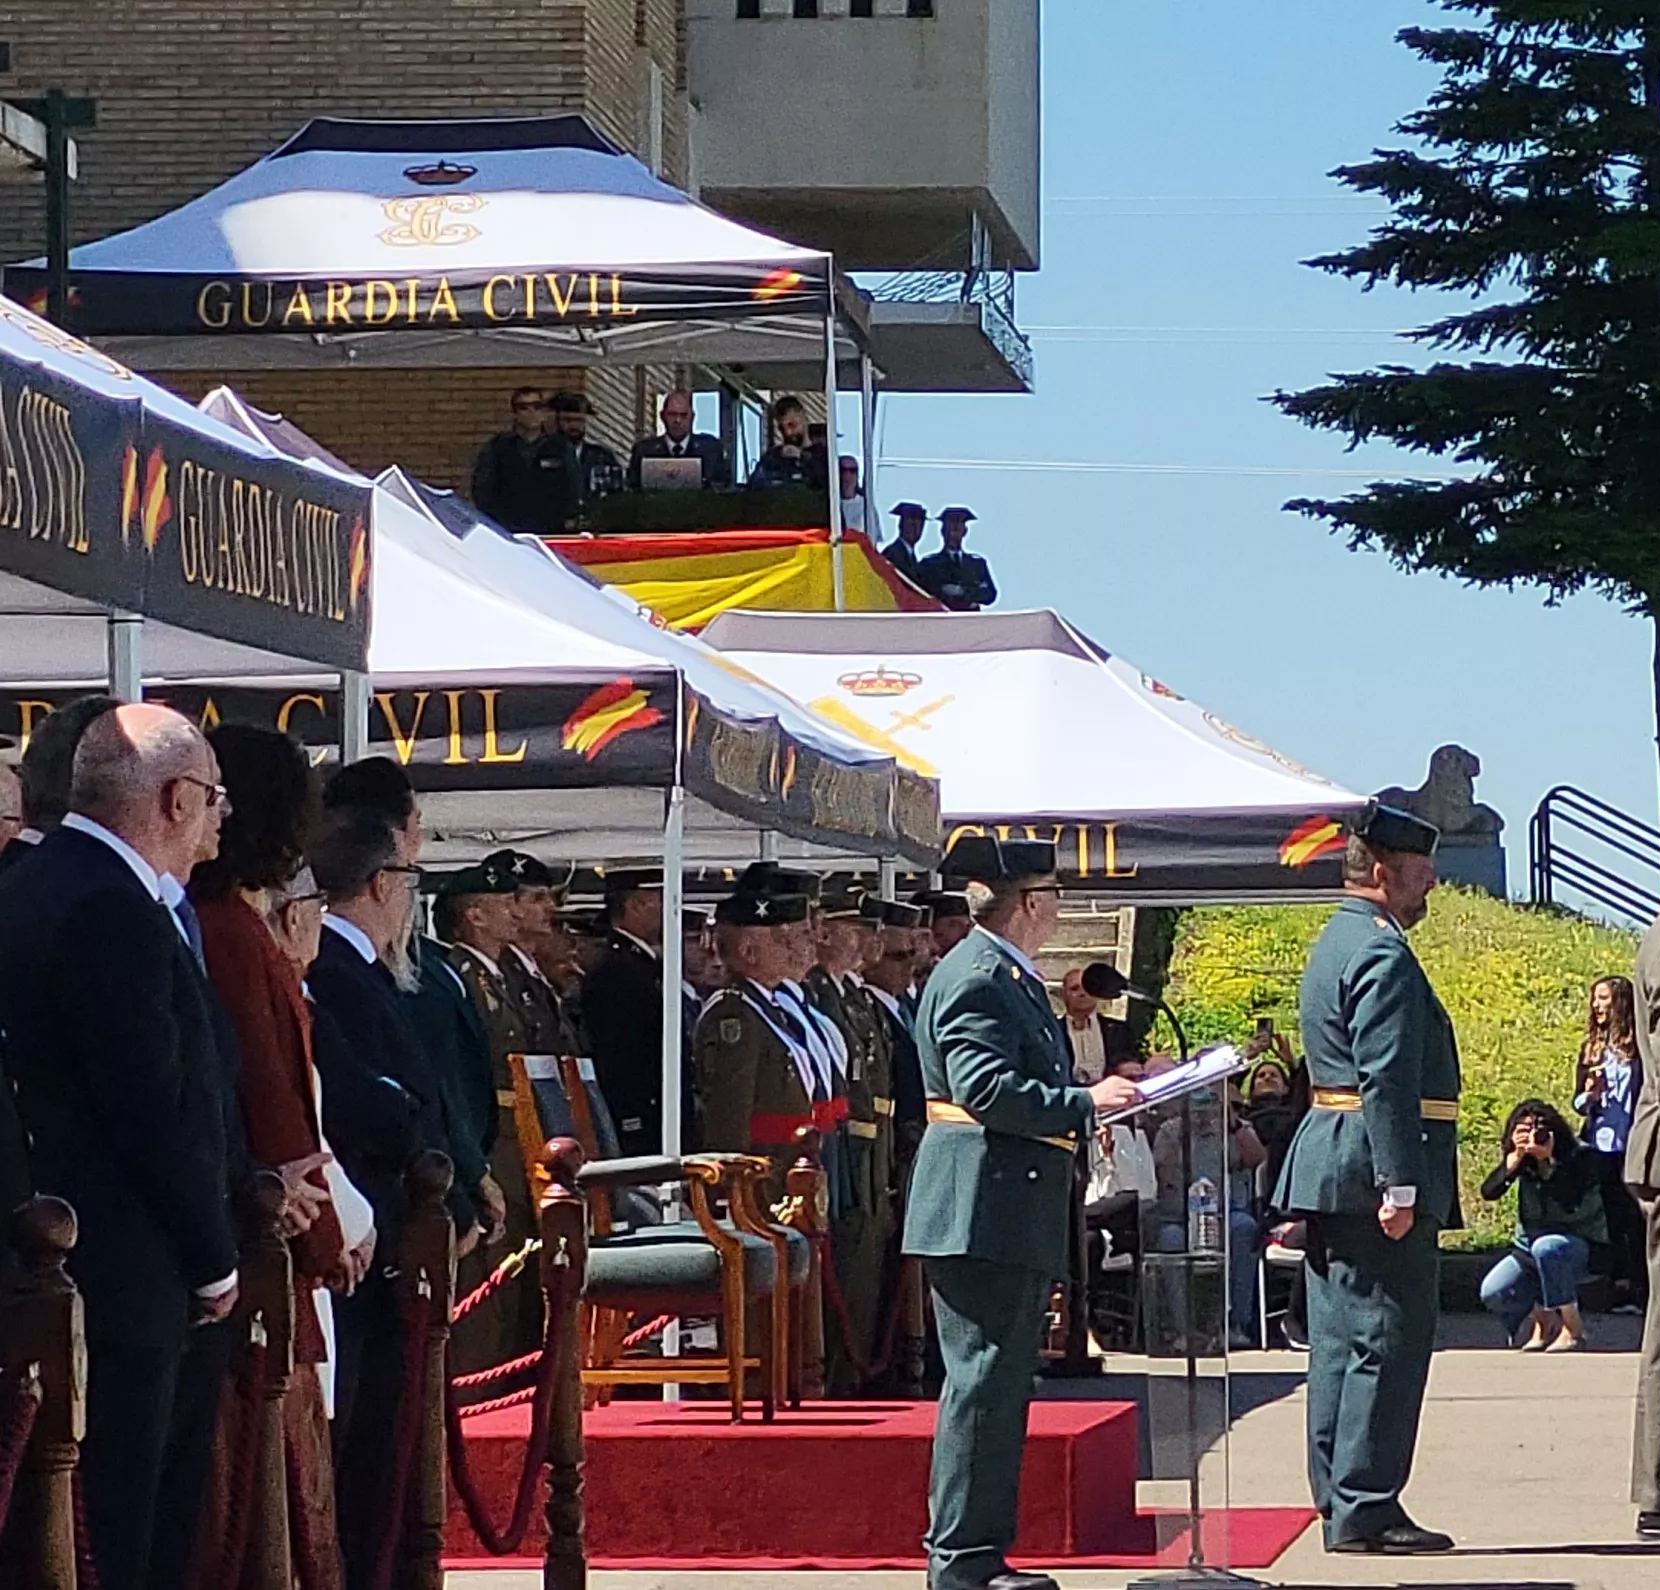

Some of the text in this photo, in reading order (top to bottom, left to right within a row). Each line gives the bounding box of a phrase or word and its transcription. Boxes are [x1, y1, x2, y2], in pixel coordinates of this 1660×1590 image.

[200, 273, 640, 328] GUARDIA CIVIL
[17, 384, 89, 555] CIVIL
[180, 460, 345, 622] GUARDIA CIVIL
[277, 689, 528, 768] CVIL
